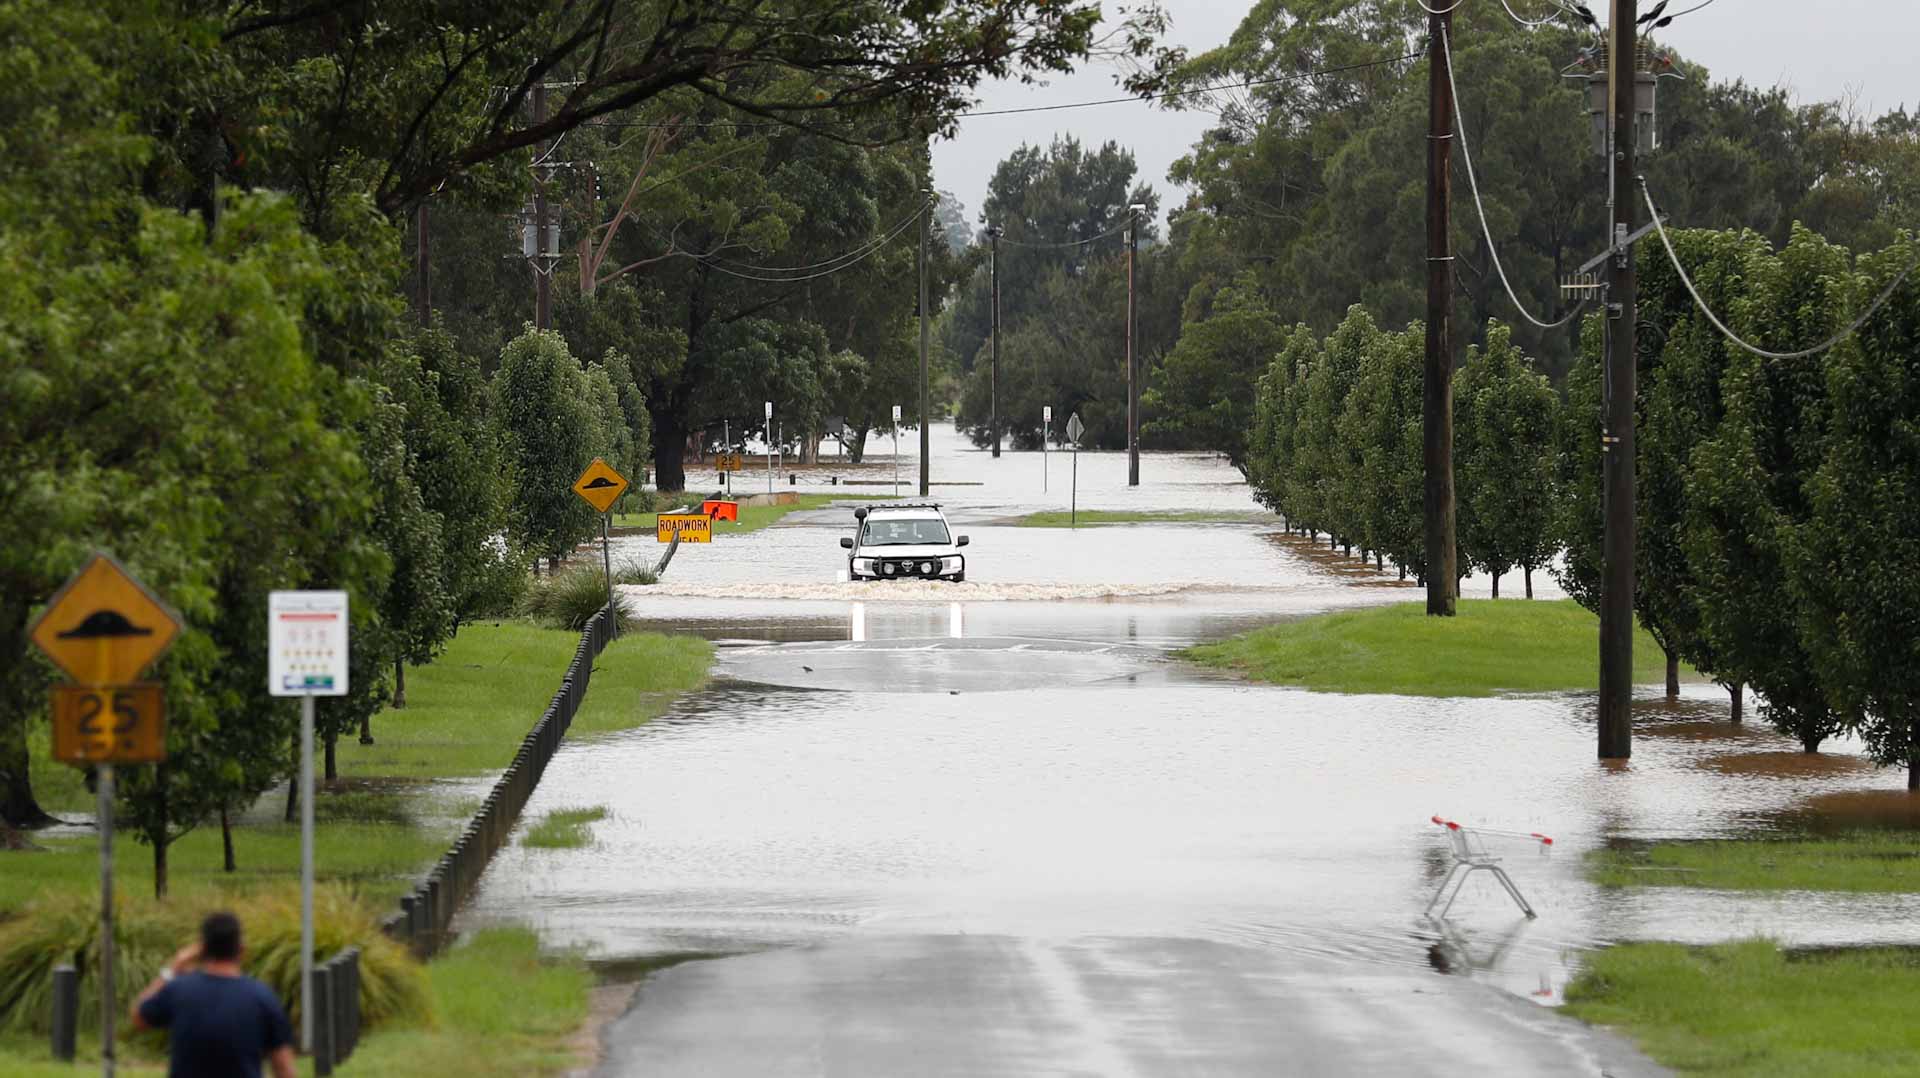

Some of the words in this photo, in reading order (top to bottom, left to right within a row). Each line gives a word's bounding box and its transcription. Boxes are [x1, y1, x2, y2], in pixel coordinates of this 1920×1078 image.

[722, 456, 734, 465] 25
[660, 519, 708, 531] ROADWORK
[79, 692, 140, 734] 25
